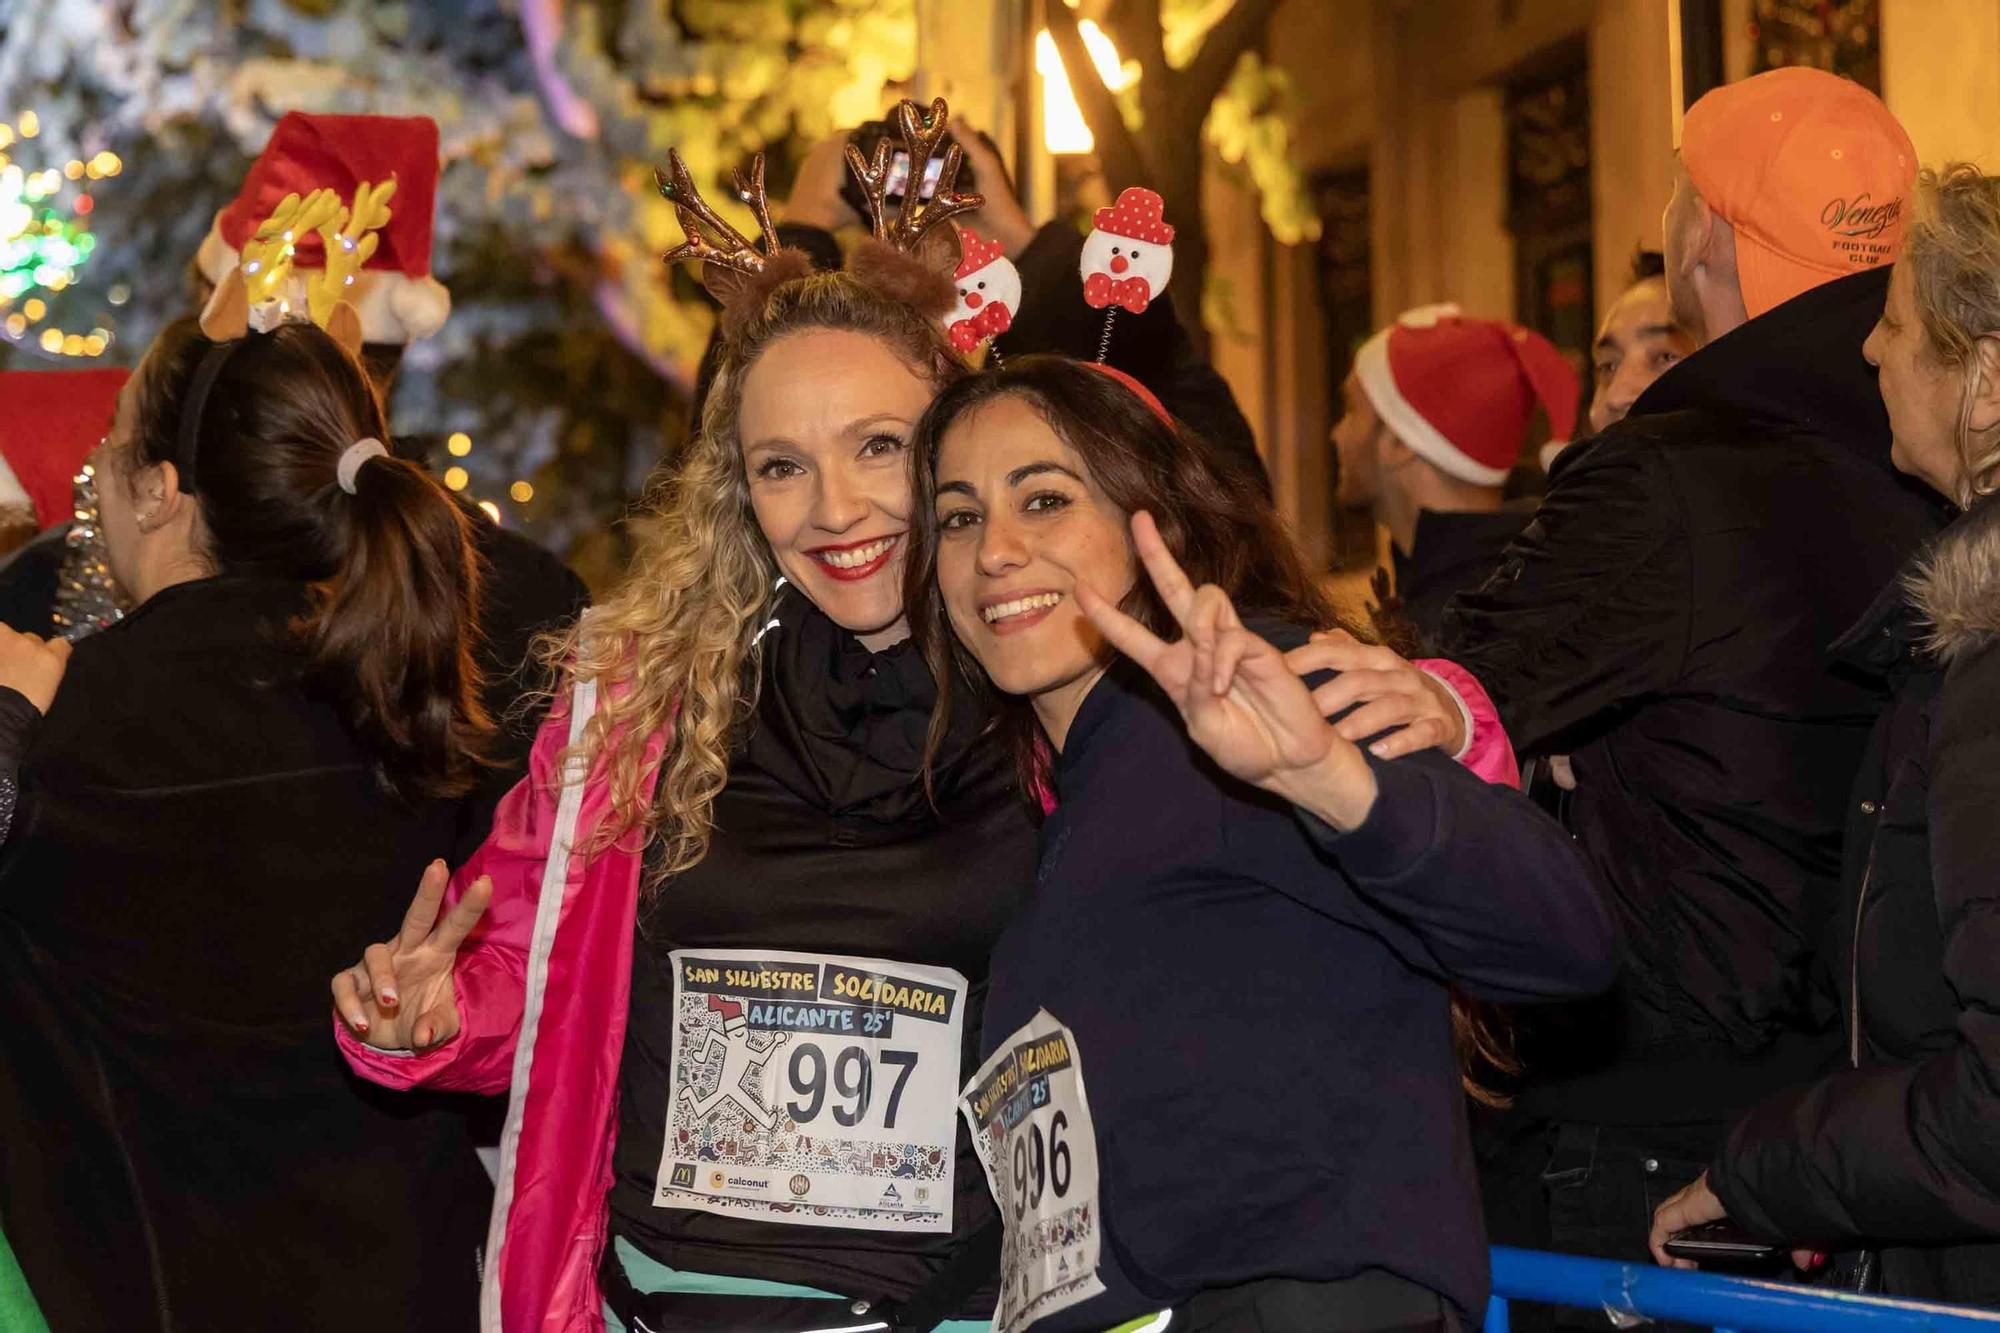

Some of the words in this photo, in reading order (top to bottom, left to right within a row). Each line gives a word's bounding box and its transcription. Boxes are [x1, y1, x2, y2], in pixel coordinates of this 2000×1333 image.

[684, 965, 720, 984] SAN
[724, 968, 816, 991] SILVESTRE
[832, 972, 947, 1016] SOLIDARIA
[749, 1004, 855, 1032] ALICANTE
[786, 1042, 919, 1129] 997
[727, 1176, 769, 1189] calconut
[1013, 1110, 1072, 1222] 996
